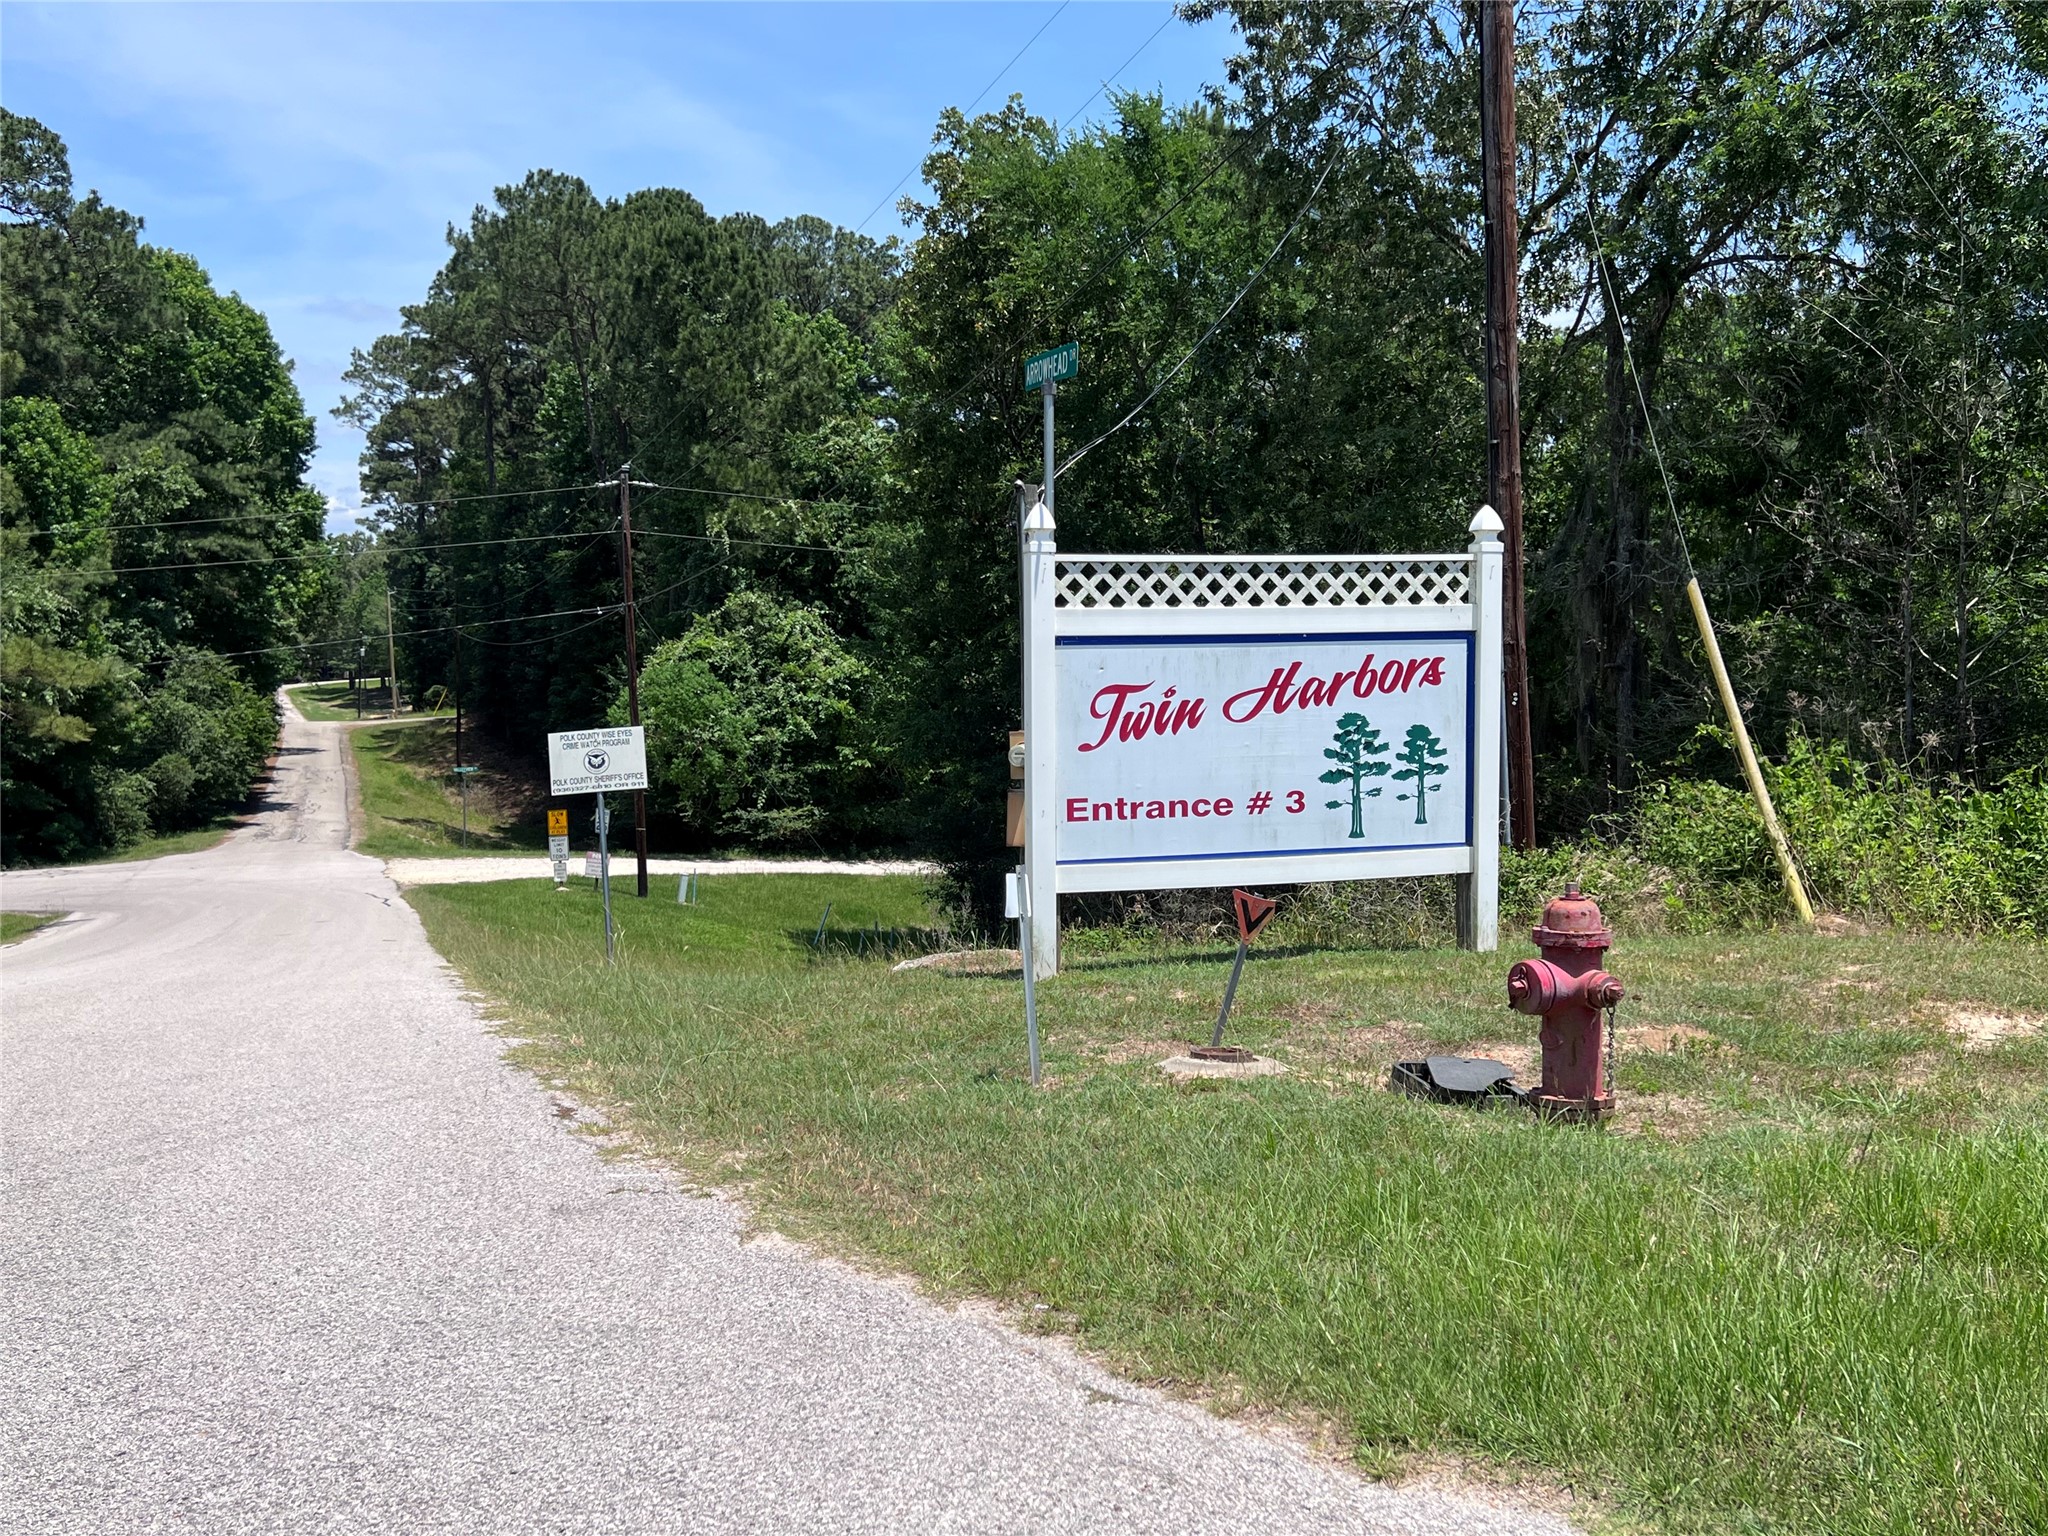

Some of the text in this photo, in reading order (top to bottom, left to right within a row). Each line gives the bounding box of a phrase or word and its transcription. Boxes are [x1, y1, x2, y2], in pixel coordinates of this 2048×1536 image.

[1026, 351, 1068, 386] ARROWHEAD
[1077, 653, 1446, 752] Twin Harbors
[560, 729, 633, 742] POLK COUNTY WISE EYES
[562, 738, 631, 751] CRIME WATCH PROGRAM
[552, 778, 568, 786] POLK
[569, 776, 593, 785] COUNTY
[623, 772, 645, 781] OFFICE
[1066, 790, 1306, 822] Entrance # 3
